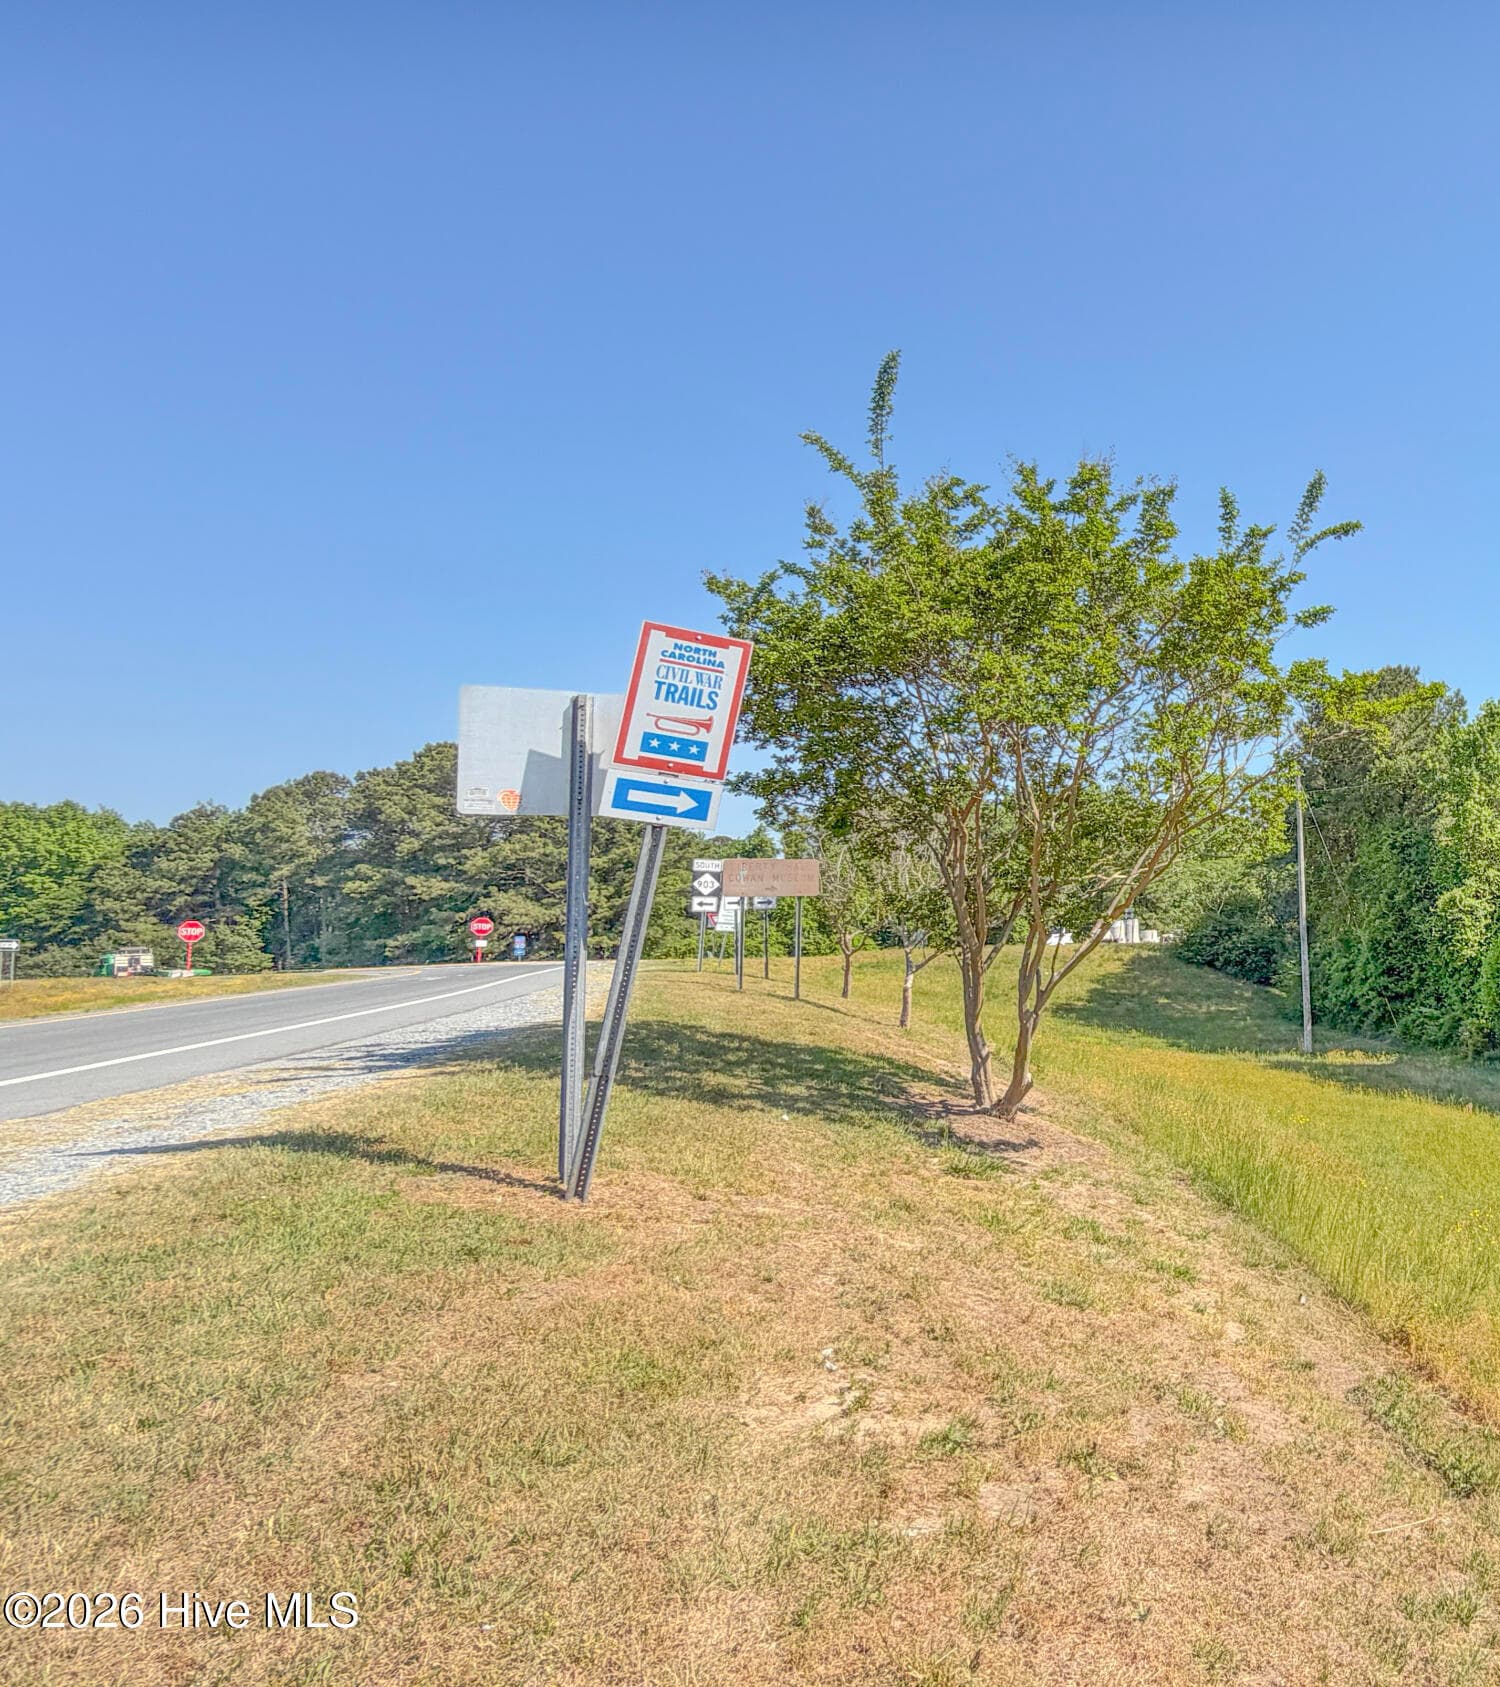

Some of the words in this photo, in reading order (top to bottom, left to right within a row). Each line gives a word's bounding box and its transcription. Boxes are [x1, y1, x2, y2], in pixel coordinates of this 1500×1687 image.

[673, 642, 717, 658] NORTH
[660, 649, 725, 669] CAROLINA
[656, 664, 692, 684] CIVIL
[695, 671, 723, 690] WAR
[654, 680, 719, 710] TRAILS
[695, 861, 720, 869] SOUTH
[697, 880, 715, 889] 903
[181, 927, 203, 936] STOP
[473, 922, 492, 931] STOP
